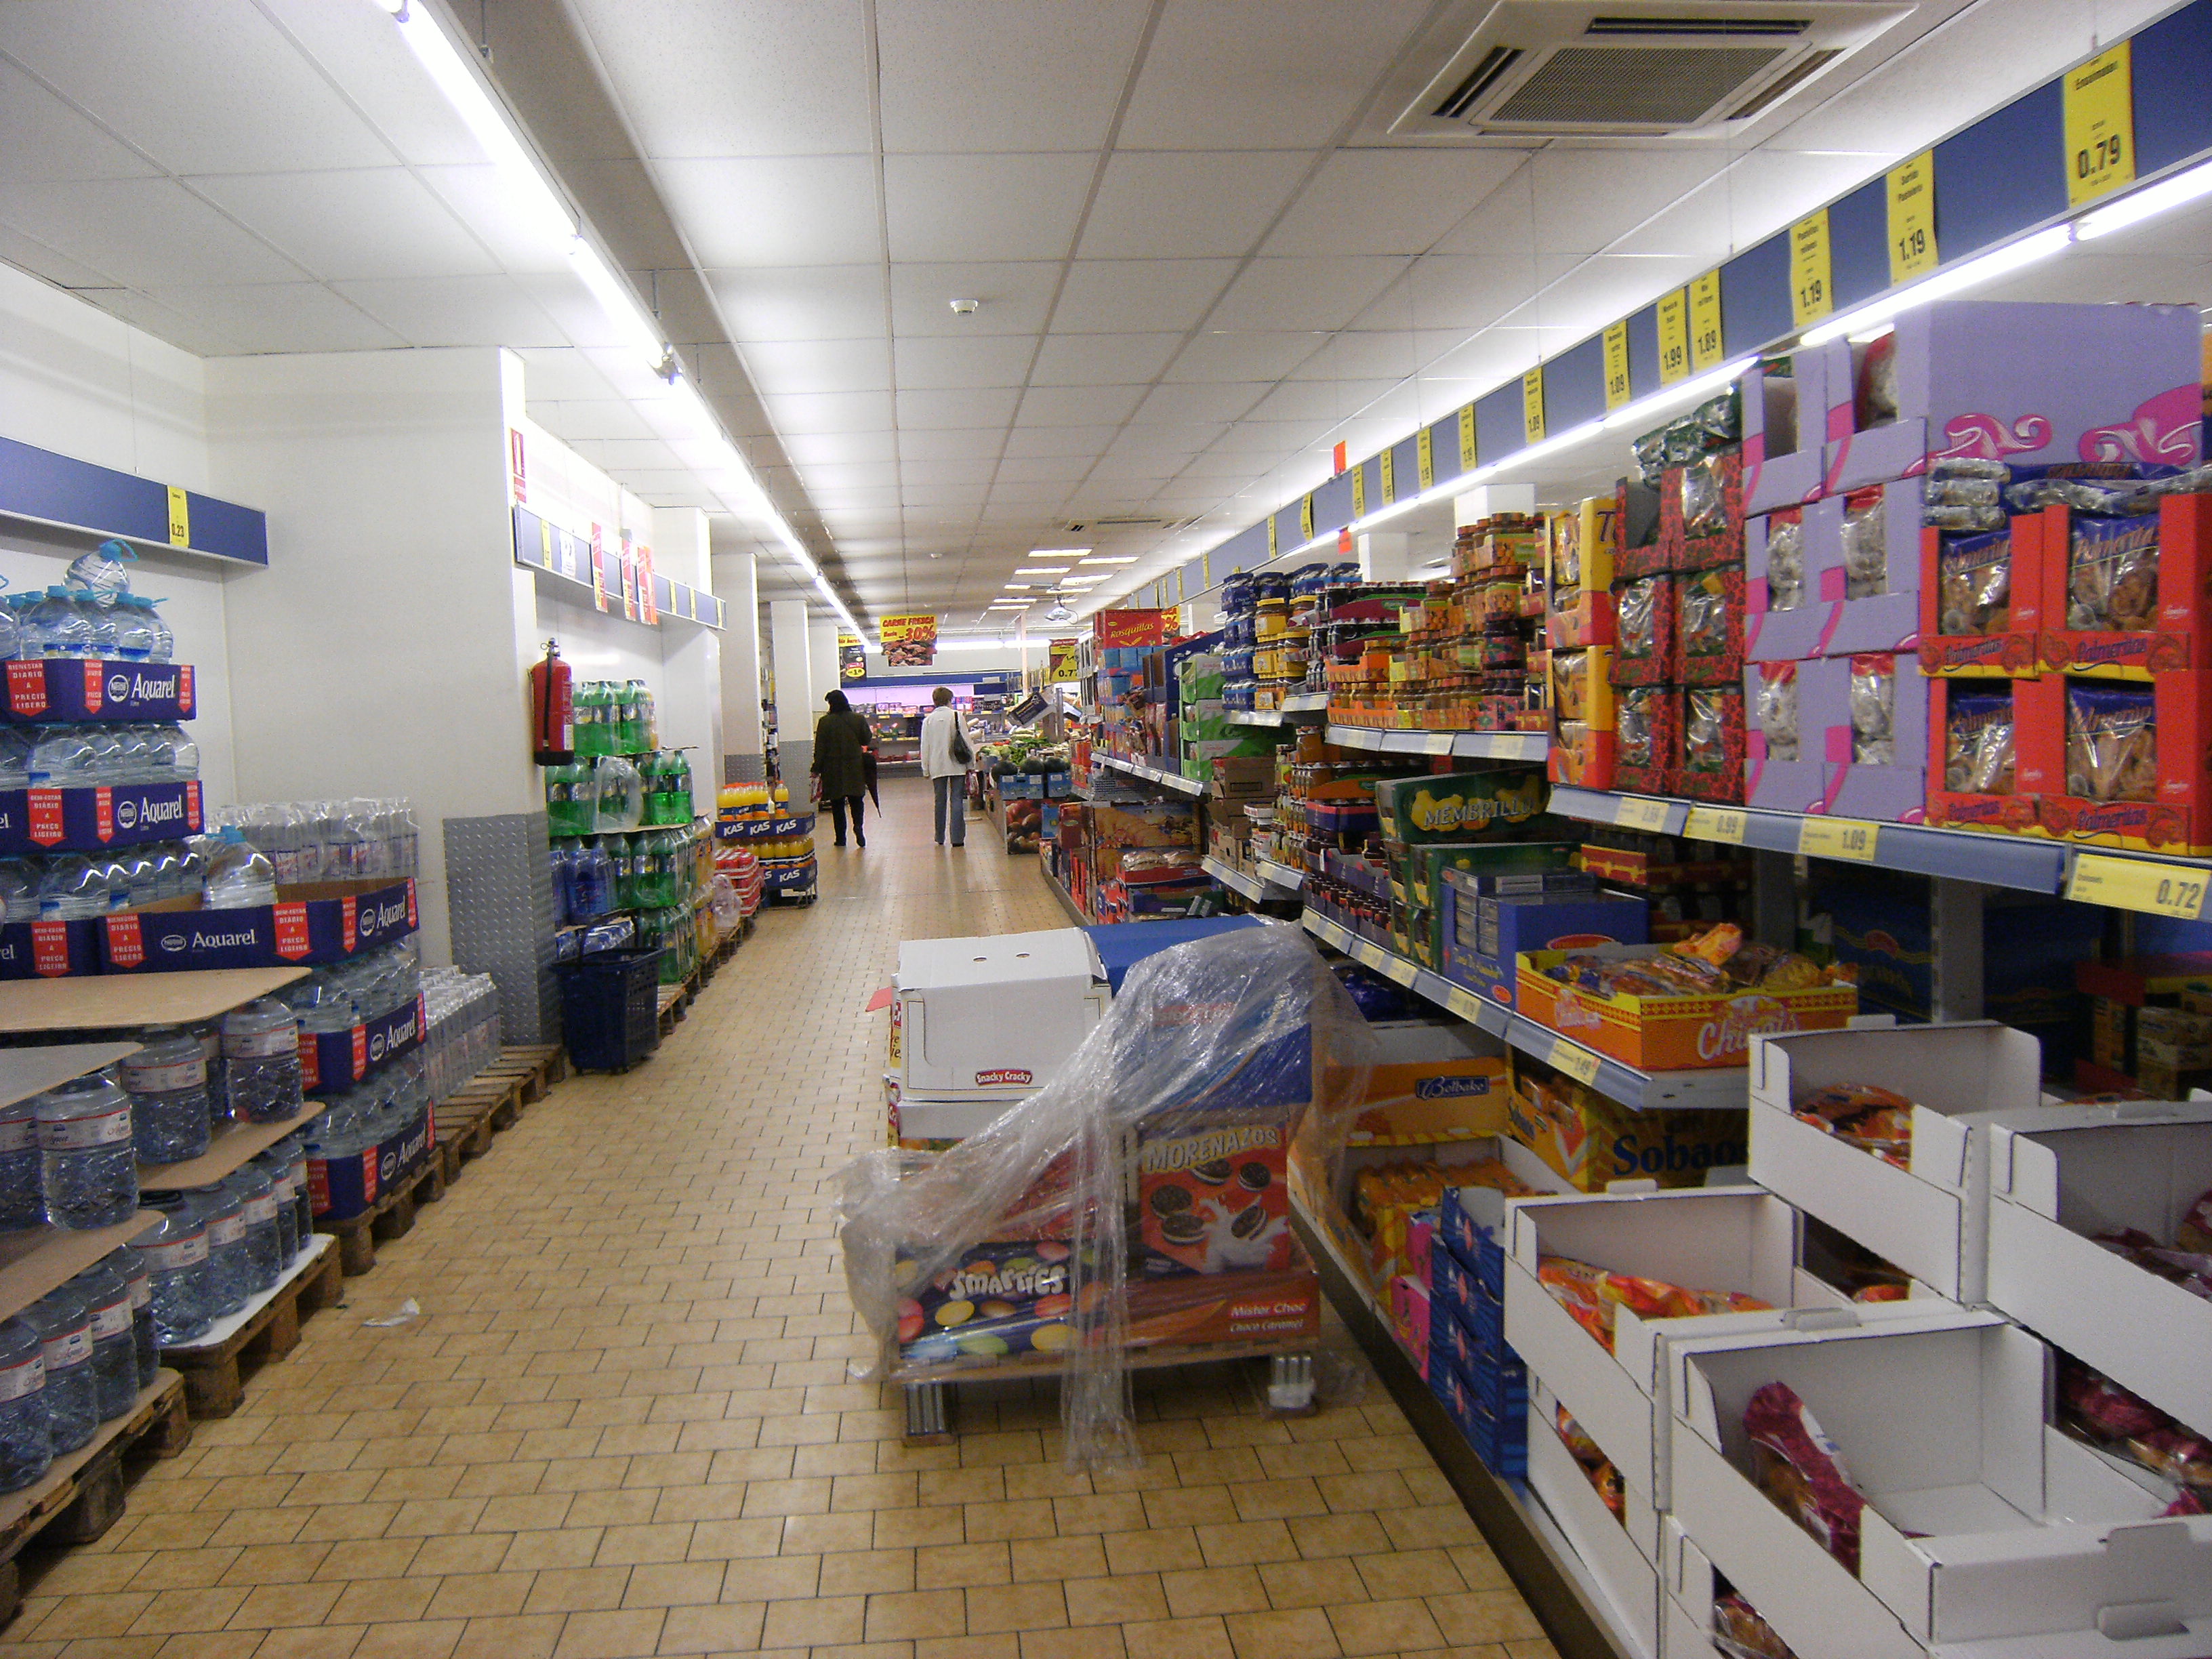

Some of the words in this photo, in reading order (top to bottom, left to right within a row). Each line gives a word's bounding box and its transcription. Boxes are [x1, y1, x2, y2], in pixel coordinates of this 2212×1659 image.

[2078, 134, 2120, 179] 0.79
[1900, 228, 1926, 261] 1.19
[1801, 280, 1822, 308] 1.19
[1664, 346, 1682, 370] 1.99
[1110, 622, 1154, 639] Rosquillas
[131, 673, 175, 701] Aquarel
[140, 794, 183, 824] Aquarel
[1425, 797, 1534, 827] MEMBRILLO
[724, 822, 744, 836] KAS
[750, 821, 770, 835] KAS
[776, 819, 797, 834] KAS
[1716, 815, 1738, 834] 0.99
[1842, 828, 1866, 851] 1.09
[779, 869, 800, 882] KAS
[2156, 878, 2201, 909] 0.72
[377, 895, 405, 929] Aquarel
[192, 928, 258, 949] Aquarel
[386, 1012, 416, 1051] Aquarel
[976, 1072, 1004, 1084] Snacky
[1005, 1071, 1031, 1084] Cracky
[1145, 1128, 1279, 1172] MORENAZOS
[1231, 1305, 1271, 1317] Mister
[1273, 1302, 1307, 1313] Choc
